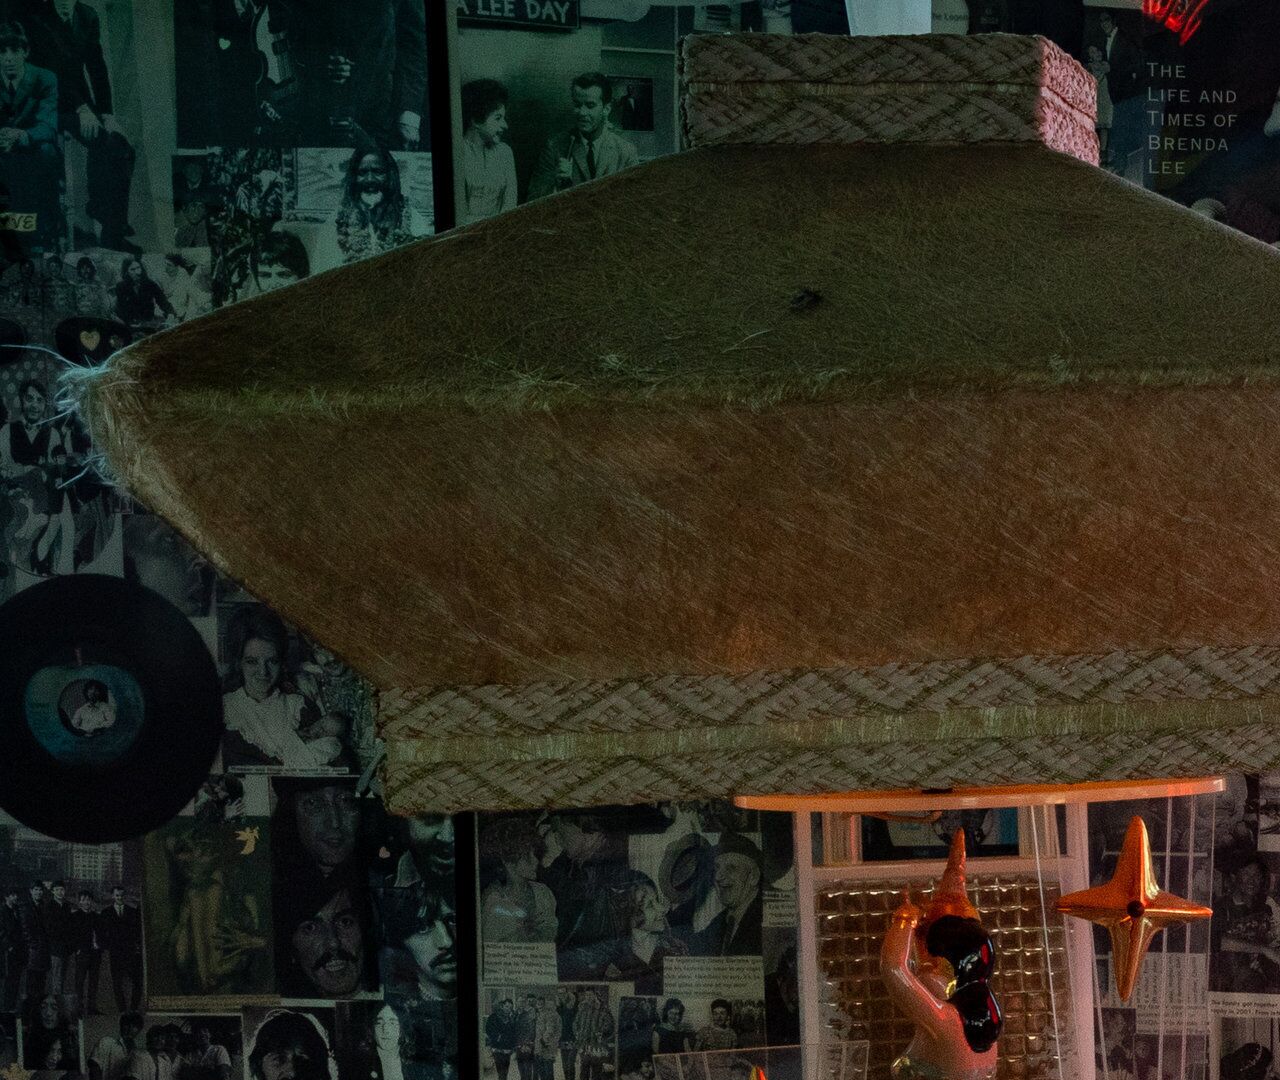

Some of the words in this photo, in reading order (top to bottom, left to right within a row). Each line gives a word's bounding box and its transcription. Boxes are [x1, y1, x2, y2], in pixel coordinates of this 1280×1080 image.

[477, 0, 516, 17] LEE
[525, 0, 570, 24] DAY
[1147, 62, 1186, 79] THE
[1147, 87, 1190, 104] LIFE
[1199, 90, 1237, 104] AND
[1147, 110, 1206, 128] TIMES
[1213, 113, 1237, 128] OF
[1147, 135, 1229, 152] BRENDA
[1147, 159, 1186, 175] LEE
